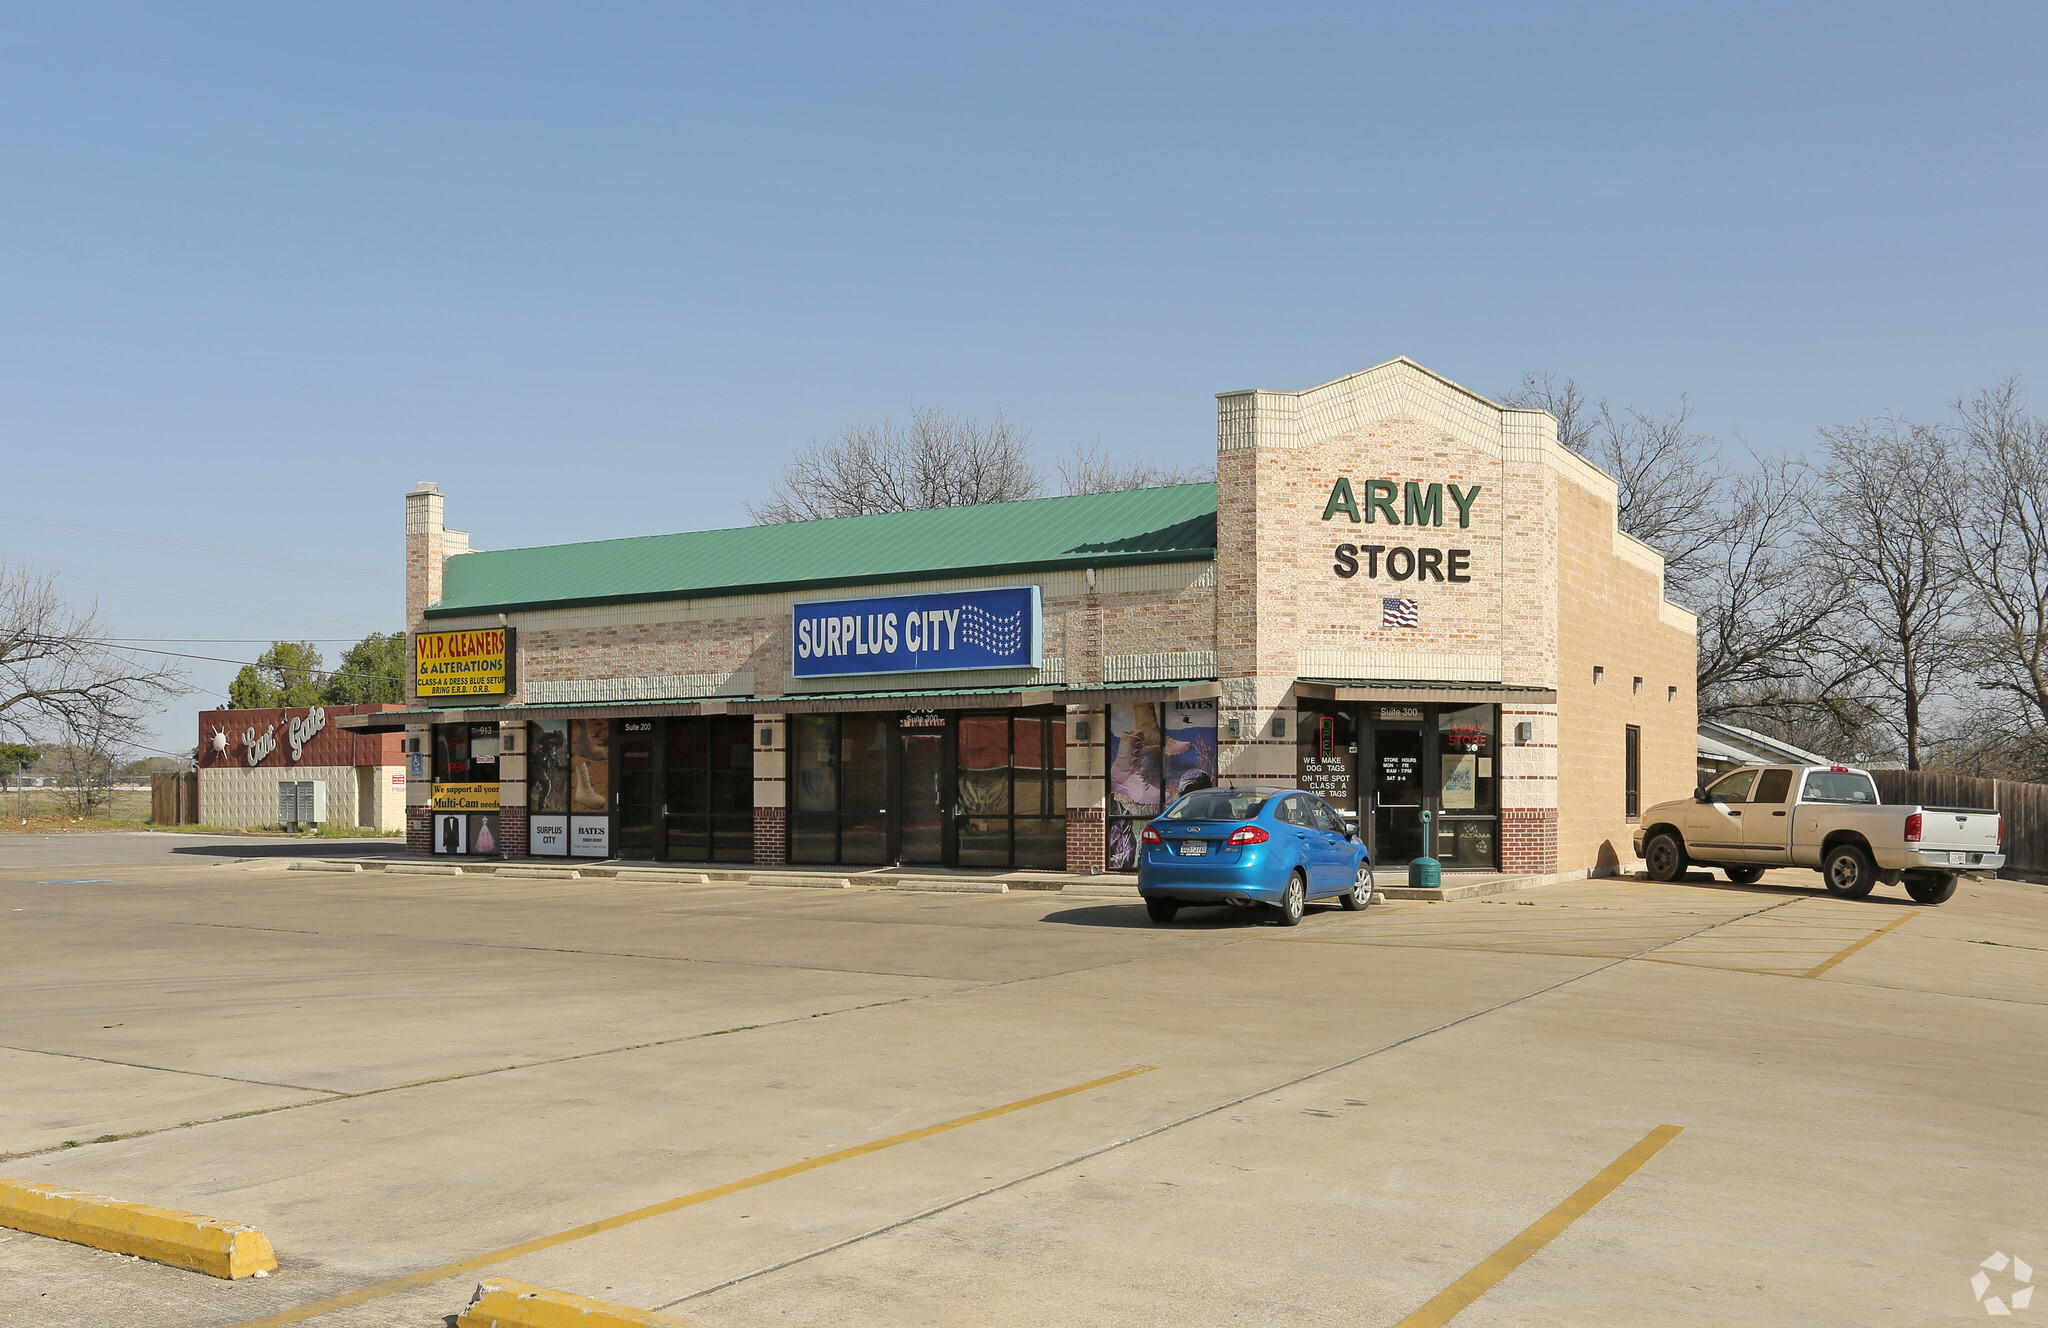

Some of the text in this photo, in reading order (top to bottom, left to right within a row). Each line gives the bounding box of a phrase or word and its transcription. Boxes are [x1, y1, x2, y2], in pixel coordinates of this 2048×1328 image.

[1322, 477, 1482, 529] ARMY
[1333, 543, 1471, 583] STORE
[798, 609, 961, 659] SURPLUS CITY
[418, 631, 504, 659] V.I.P. CLEANERS
[420, 659, 503, 674] & ALTERATIONS
[417, 678, 443, 686] CLASS-A
[449, 677, 468, 686] DRESS
[469, 677, 485, 685] BLUE
[431, 686, 450, 694] BRING
[1175, 701, 1213, 709] BATES
[1380, 708, 1418, 716] Suite 300
[480, 726, 492, 735] 913
[625, 723, 640, 731] Suite
[1451, 723, 1486, 734] ARMY
[288, 705, 326, 762] Gate
[1322, 719, 1332, 759] OPEN
[1448, 735, 1487, 746] STORE
[433, 785, 500, 794] We support all your
[433, 797, 500, 808] Multi-Cam needs
[536, 826, 562, 834] SURPLUS
[578, 827, 605, 835] BATES
[543, 836, 556, 844] CITY
